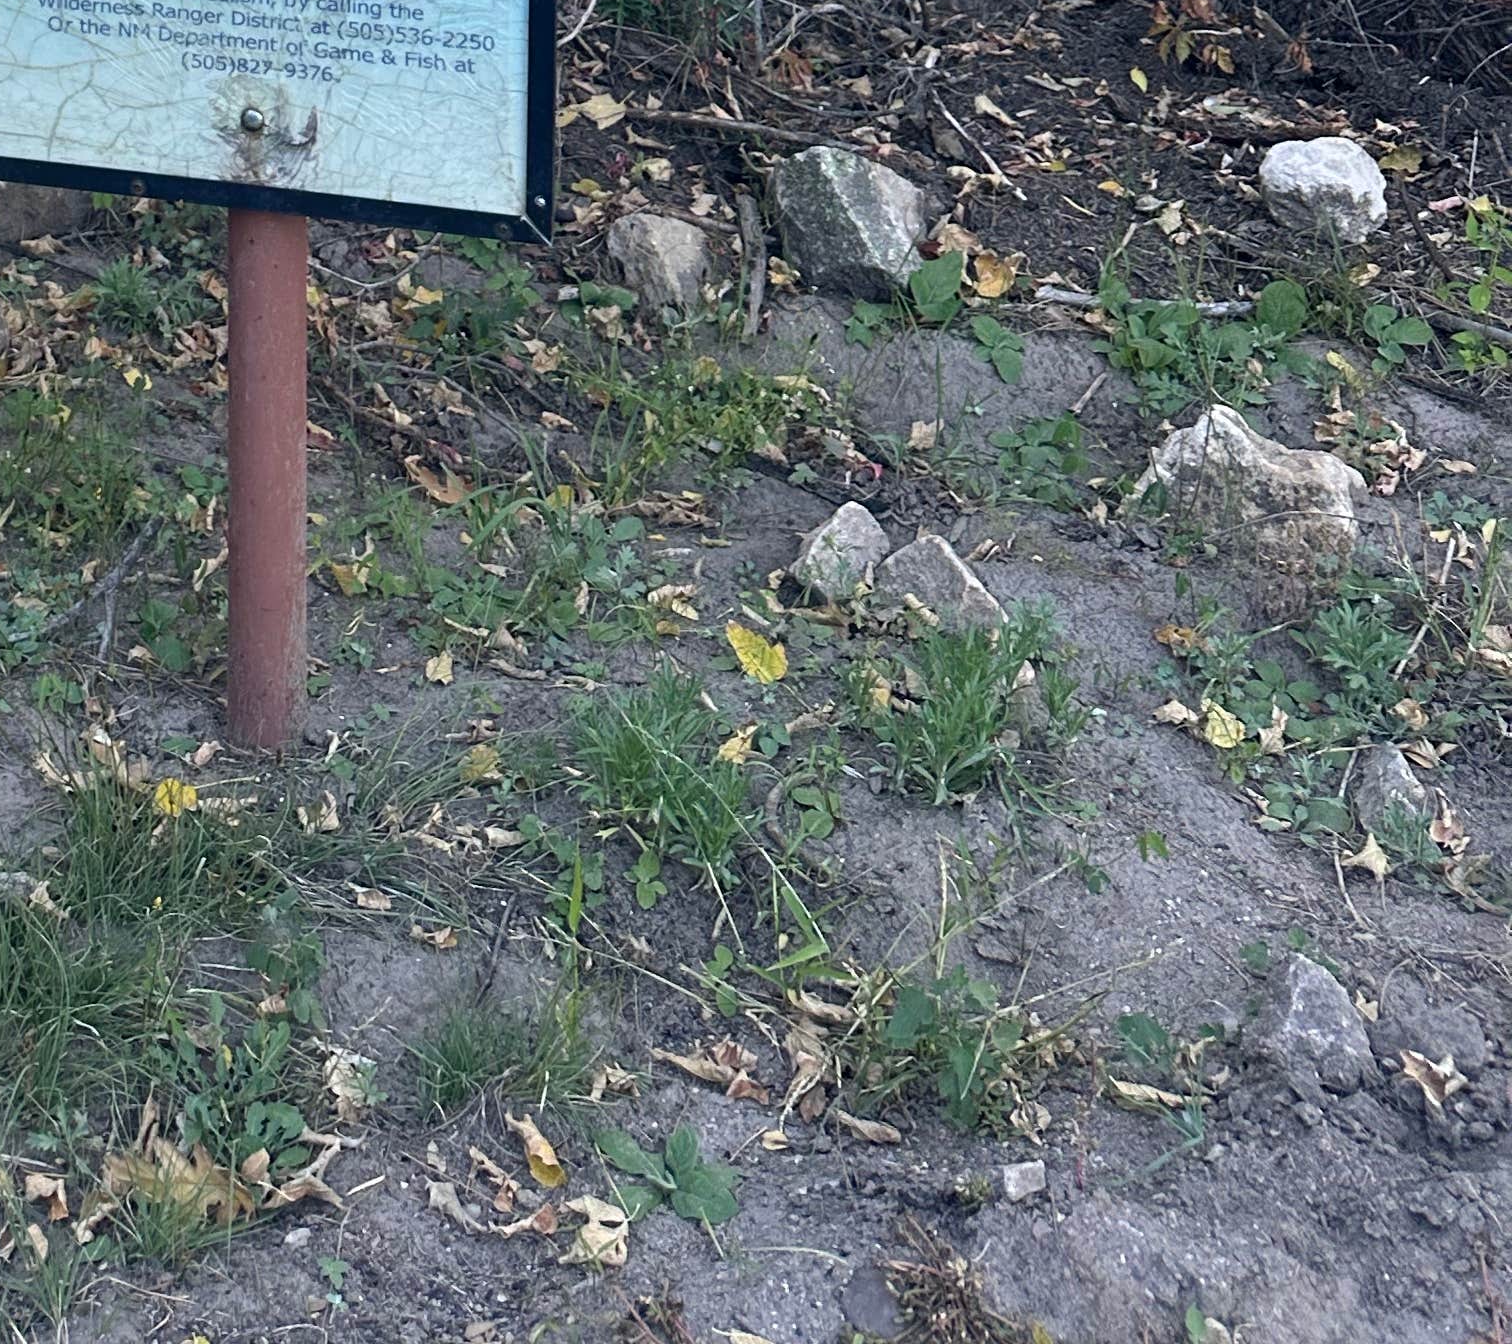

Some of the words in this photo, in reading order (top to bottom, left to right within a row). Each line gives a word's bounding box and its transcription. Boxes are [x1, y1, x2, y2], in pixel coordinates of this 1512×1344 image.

[152, 2, 224, 26] Ranger
[231, 10, 302, 33] District
[310, 20, 330, 35] at
[337, 20, 496, 52] (505)536-2250
[389, 3, 424, 21] the
[48, 15, 73, 33] Or
[80, 18, 111, 37] the
[118, 22, 152, 41] NM
[158, 26, 278, 52] Department
[286, 38, 308, 56] of
[313, 42, 374, 64] Game
[381, 49, 398, 66] &
[405, 51, 446, 71] Fish
[454, 58, 476, 75] at
